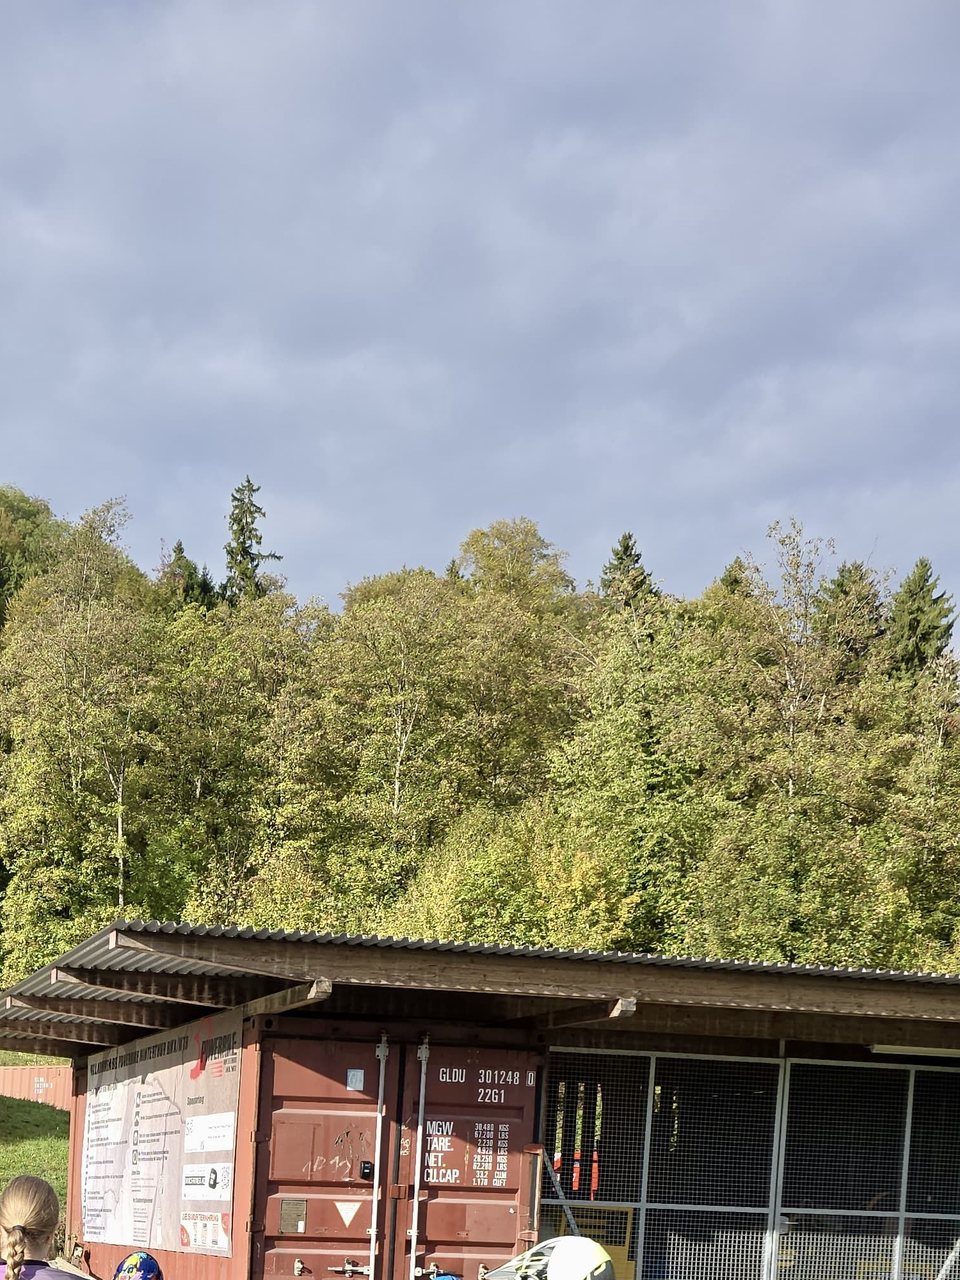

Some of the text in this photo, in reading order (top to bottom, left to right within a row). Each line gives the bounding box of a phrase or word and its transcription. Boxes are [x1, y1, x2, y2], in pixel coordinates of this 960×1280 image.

[439, 1067, 466, 1083] GLDU
[478, 1069, 520, 1085] 301248
[477, 1088, 505, 1103] 22G1
[426, 1136, 454, 1151] TARE.
[424, 1152, 446, 1167] NET.
[496, 1163, 507, 1171] LBS
[424, 1168, 460, 1183] CU.CAP.
